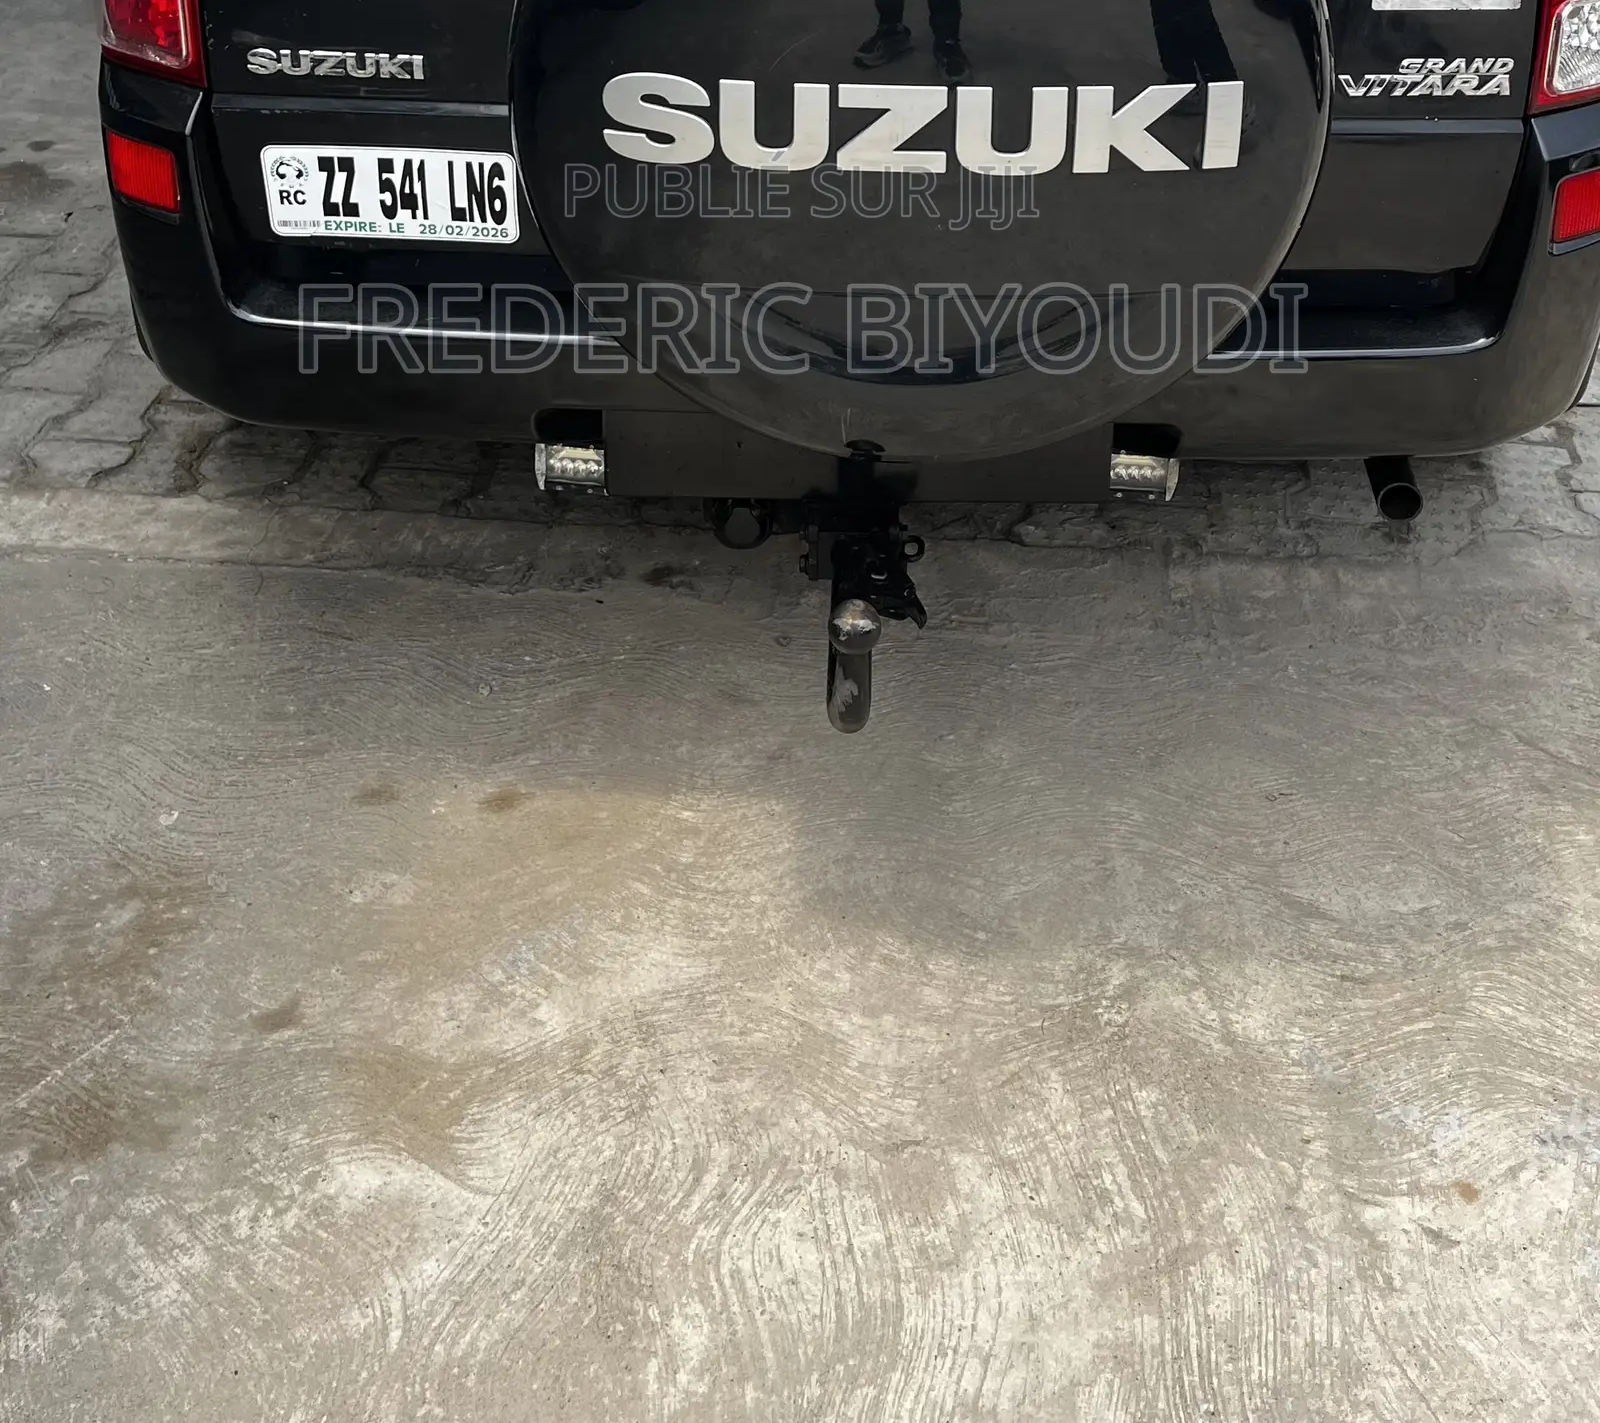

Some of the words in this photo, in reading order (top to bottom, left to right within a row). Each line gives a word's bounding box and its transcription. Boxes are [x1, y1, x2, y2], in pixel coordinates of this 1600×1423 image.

[247, 48, 425, 80] SUZUKI
[1398, 57, 1515, 75] GRAND
[1337, 74, 1512, 97] VITARA
[602, 72, 1244, 175] SUZUKI
[278, 189, 308, 206] RC
[317, 156, 360, 218] ZZ
[377, 157, 429, 221] 541
[447, 160, 508, 226] LN6
[324, 220, 383, 233] EXPIRE:
[389, 222, 405, 234] LE
[419, 223, 509, 239] 28/02/2026
